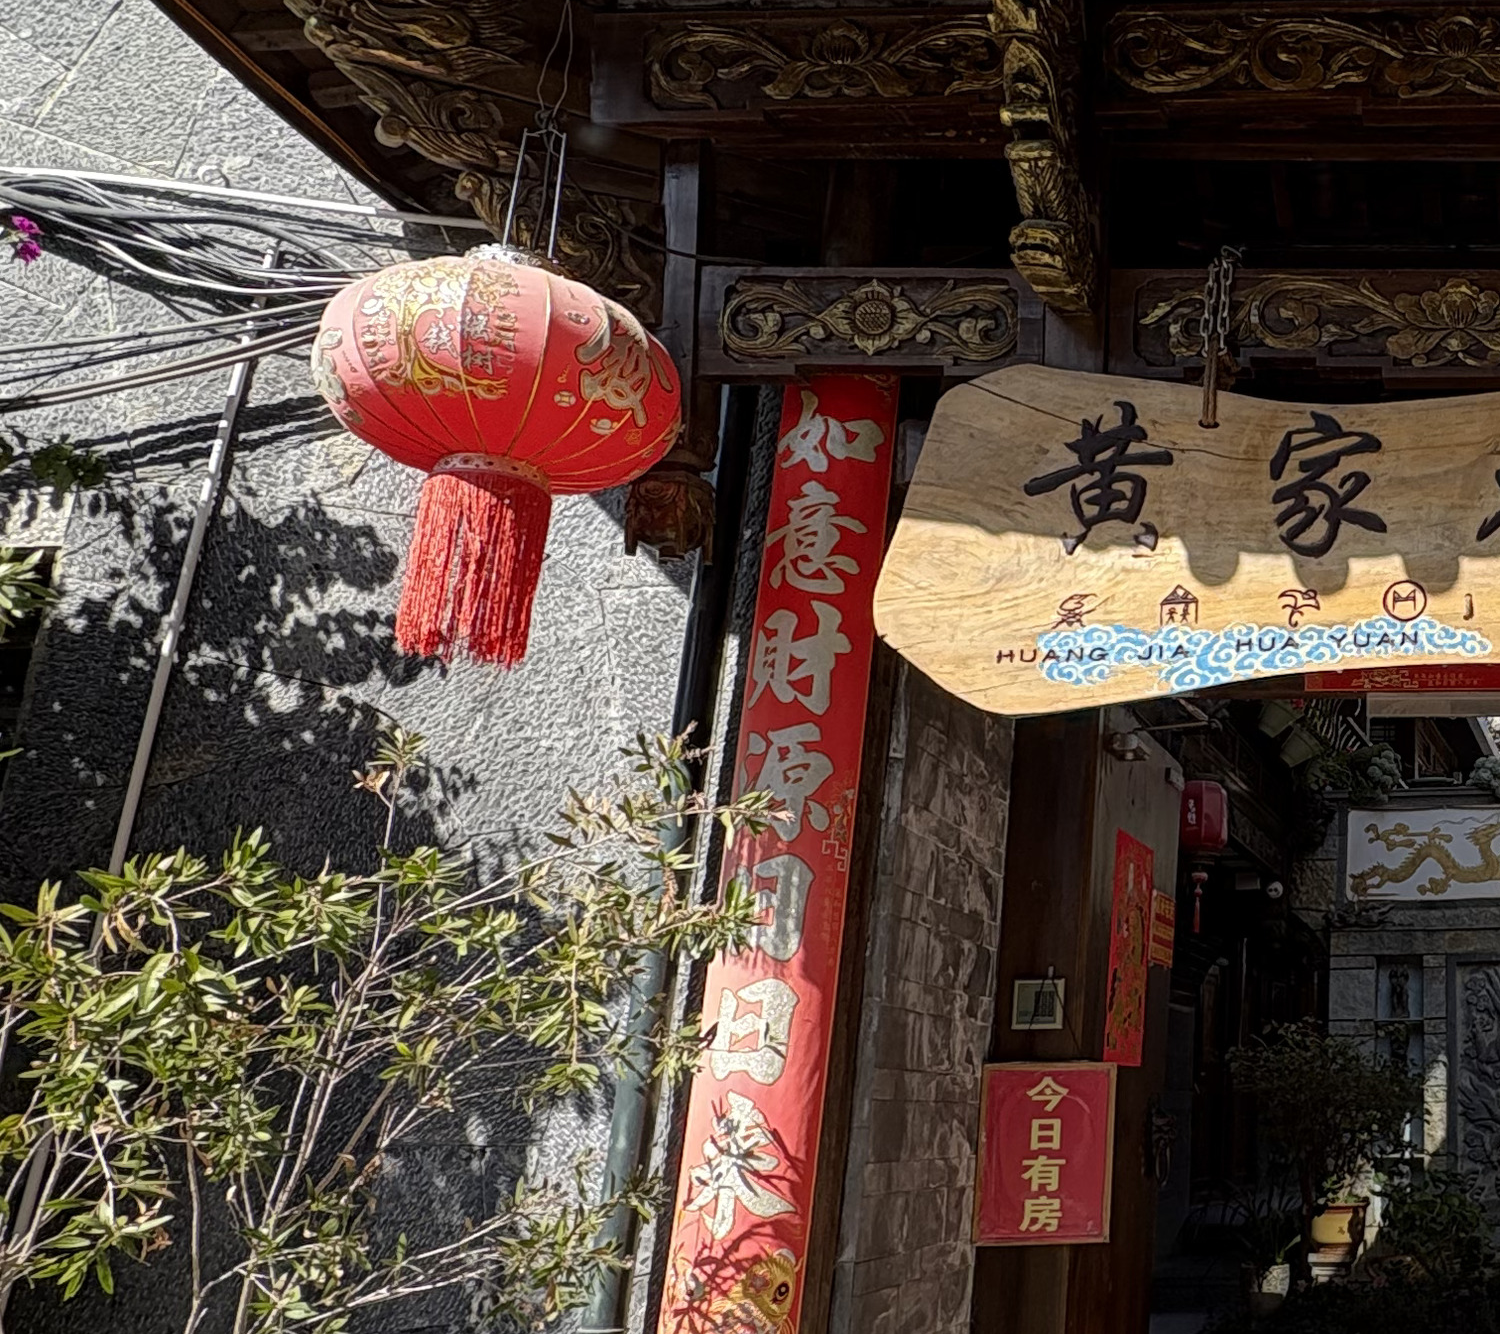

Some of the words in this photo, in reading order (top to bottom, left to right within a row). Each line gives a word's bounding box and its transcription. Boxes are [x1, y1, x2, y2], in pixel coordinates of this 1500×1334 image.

[996, 646, 1108, 666] HUANG
[1137, 643, 1191, 663] JIA
[1236, 635, 1299, 654] HUA
[1330, 629, 1420, 650] YUAN
[1018, 1075, 1071, 1233] 今日有房
